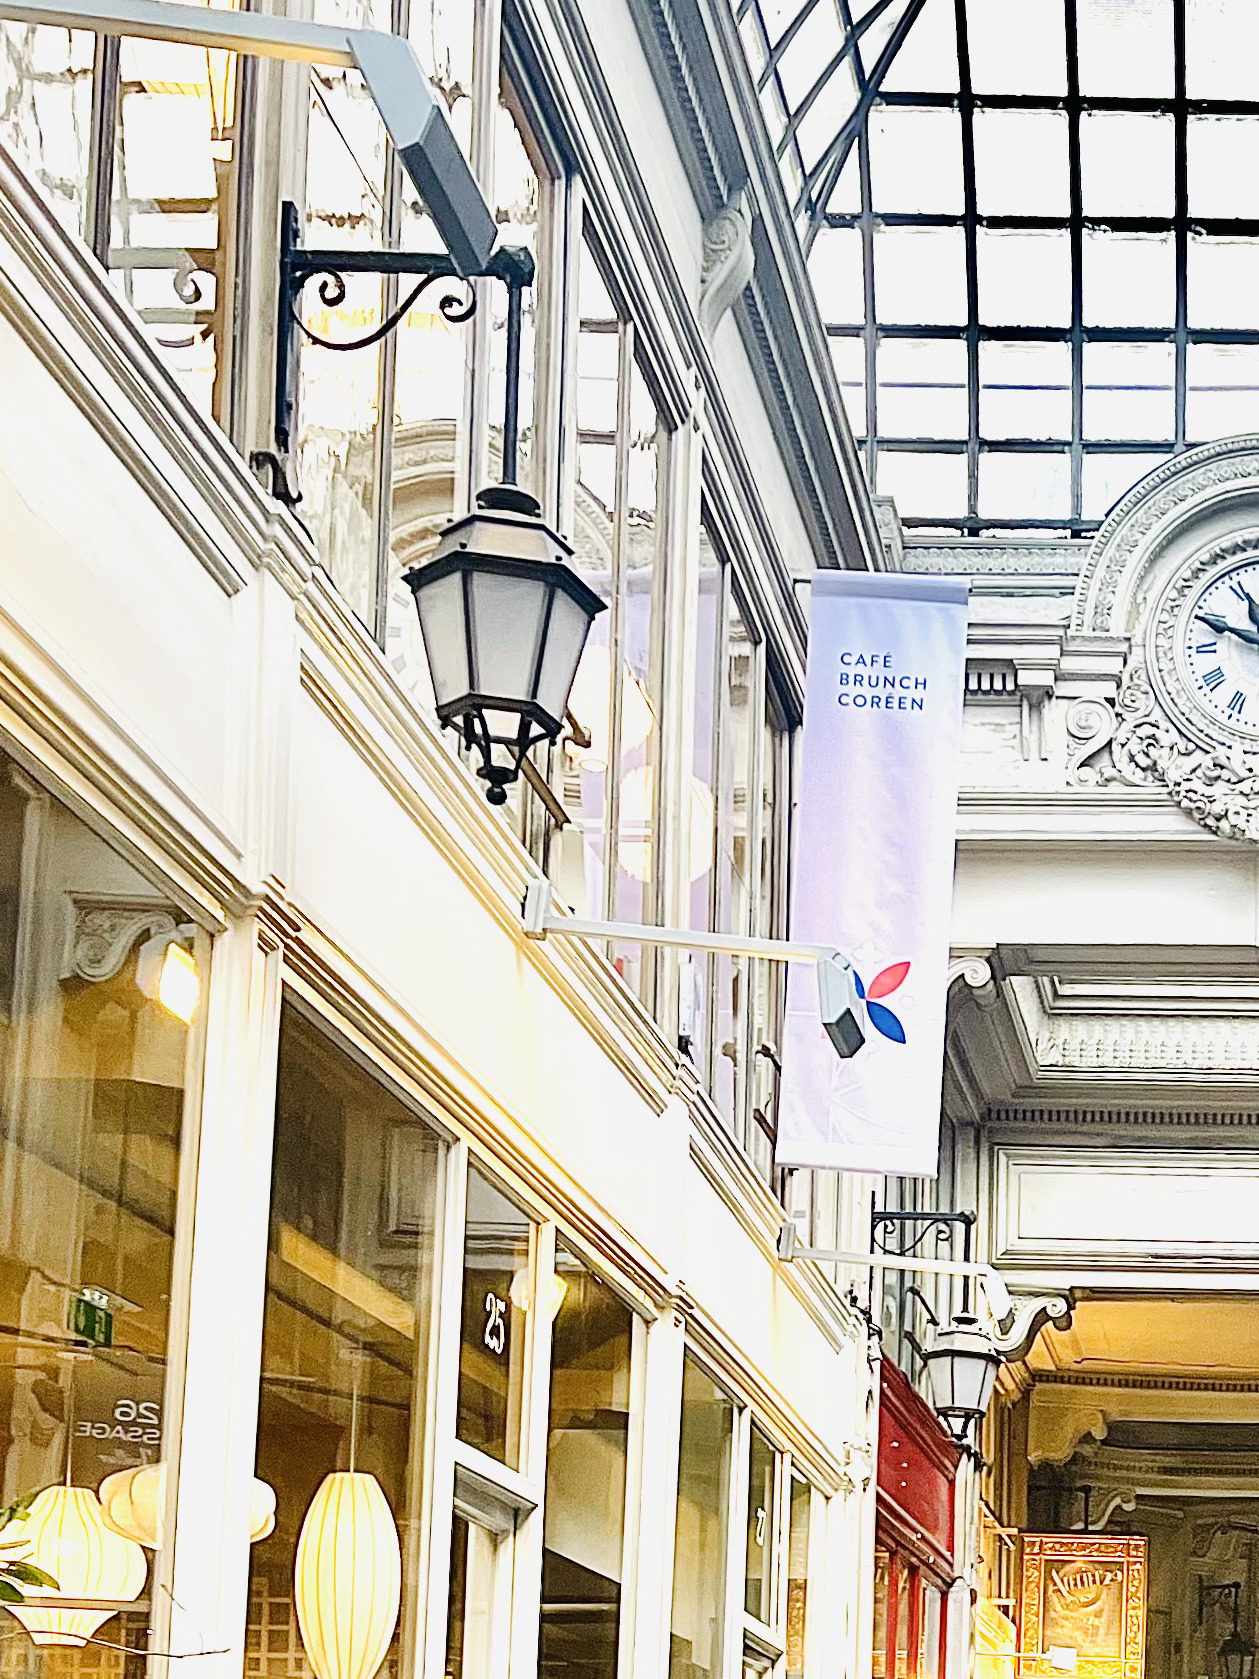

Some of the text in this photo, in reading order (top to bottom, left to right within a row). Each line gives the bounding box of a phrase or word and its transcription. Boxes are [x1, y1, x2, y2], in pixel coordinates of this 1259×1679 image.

[840, 651, 893, 669] CAFÉ
[839, 672, 927, 691] BRUNCH
[837, 691, 924, 711] CORÉEN
[484, 1292, 506, 1355] 25
